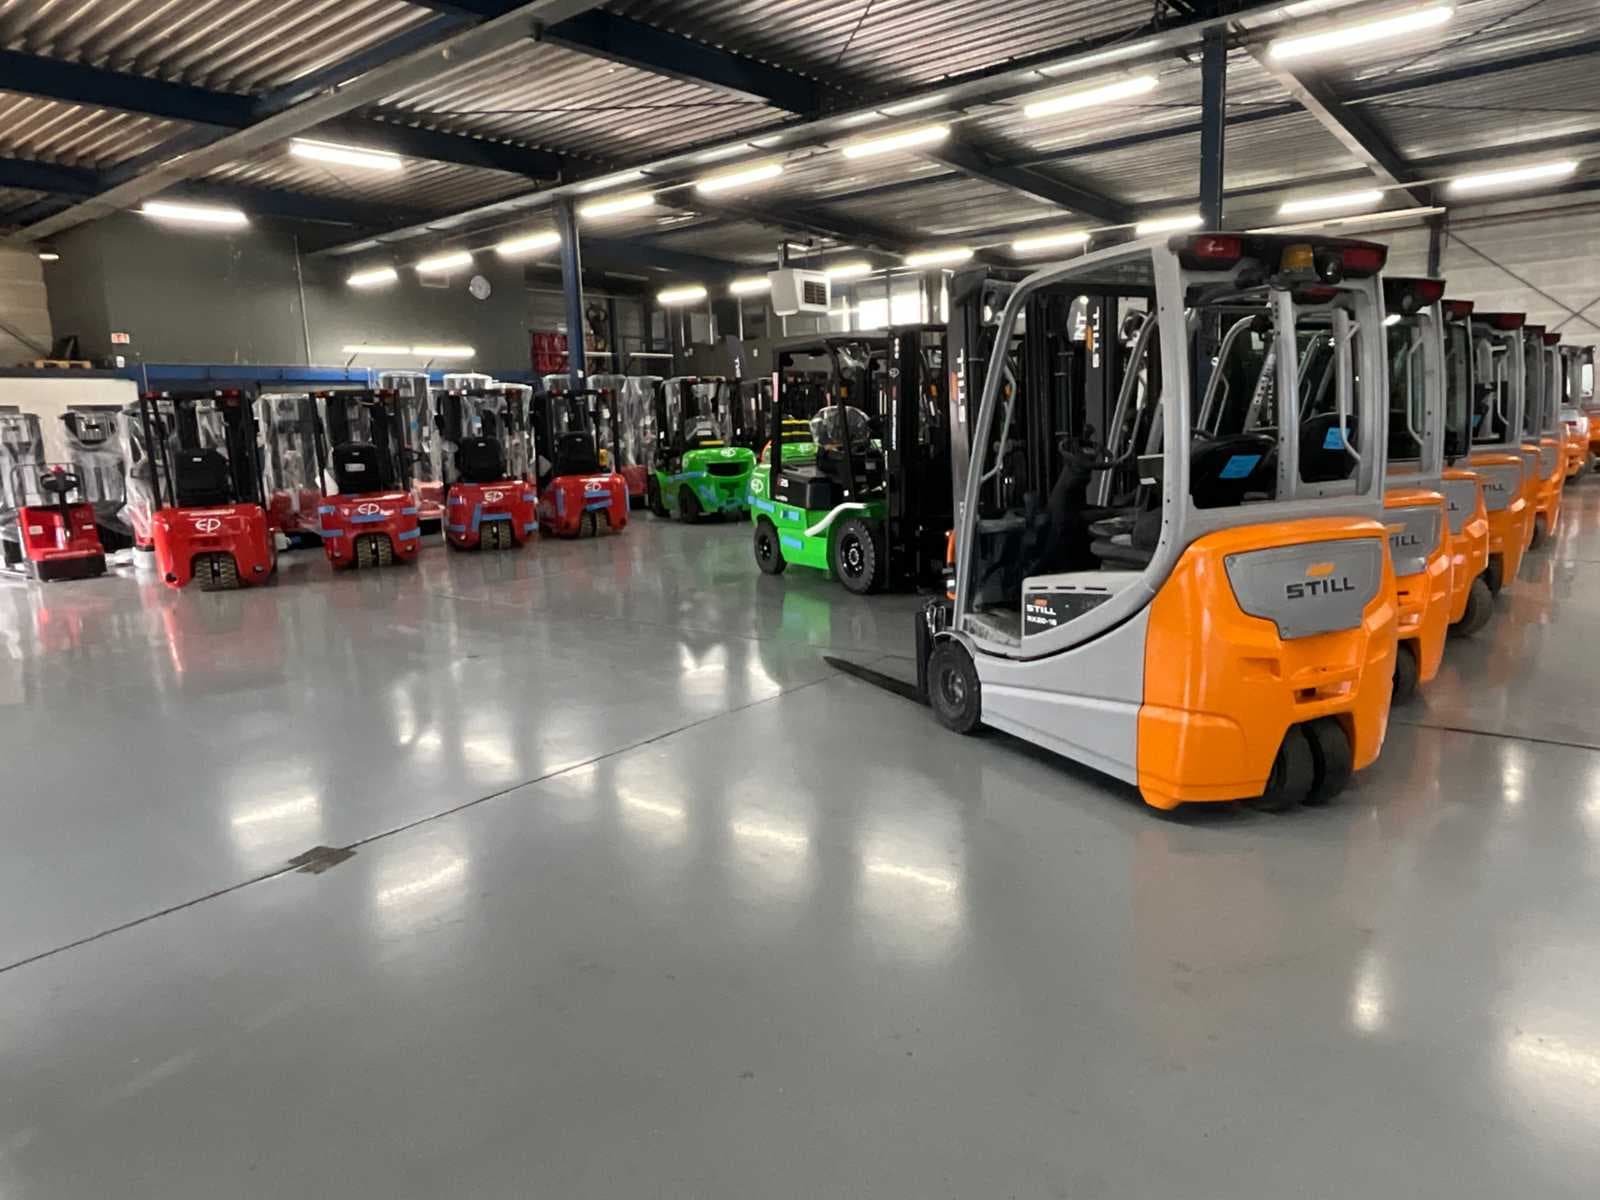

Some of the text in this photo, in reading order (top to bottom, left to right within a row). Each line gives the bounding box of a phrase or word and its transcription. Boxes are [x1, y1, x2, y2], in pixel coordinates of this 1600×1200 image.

[1092, 305, 1100, 369] STILL
[956, 347, 966, 423] STILL
[1481, 483, 1504, 492] TILL
[195, 518, 221, 533] EP
[1389, 535, 1421, 547] ILL
[1286, 577, 1355, 599] STILL
[1026, 604, 1057, 615] STILL
